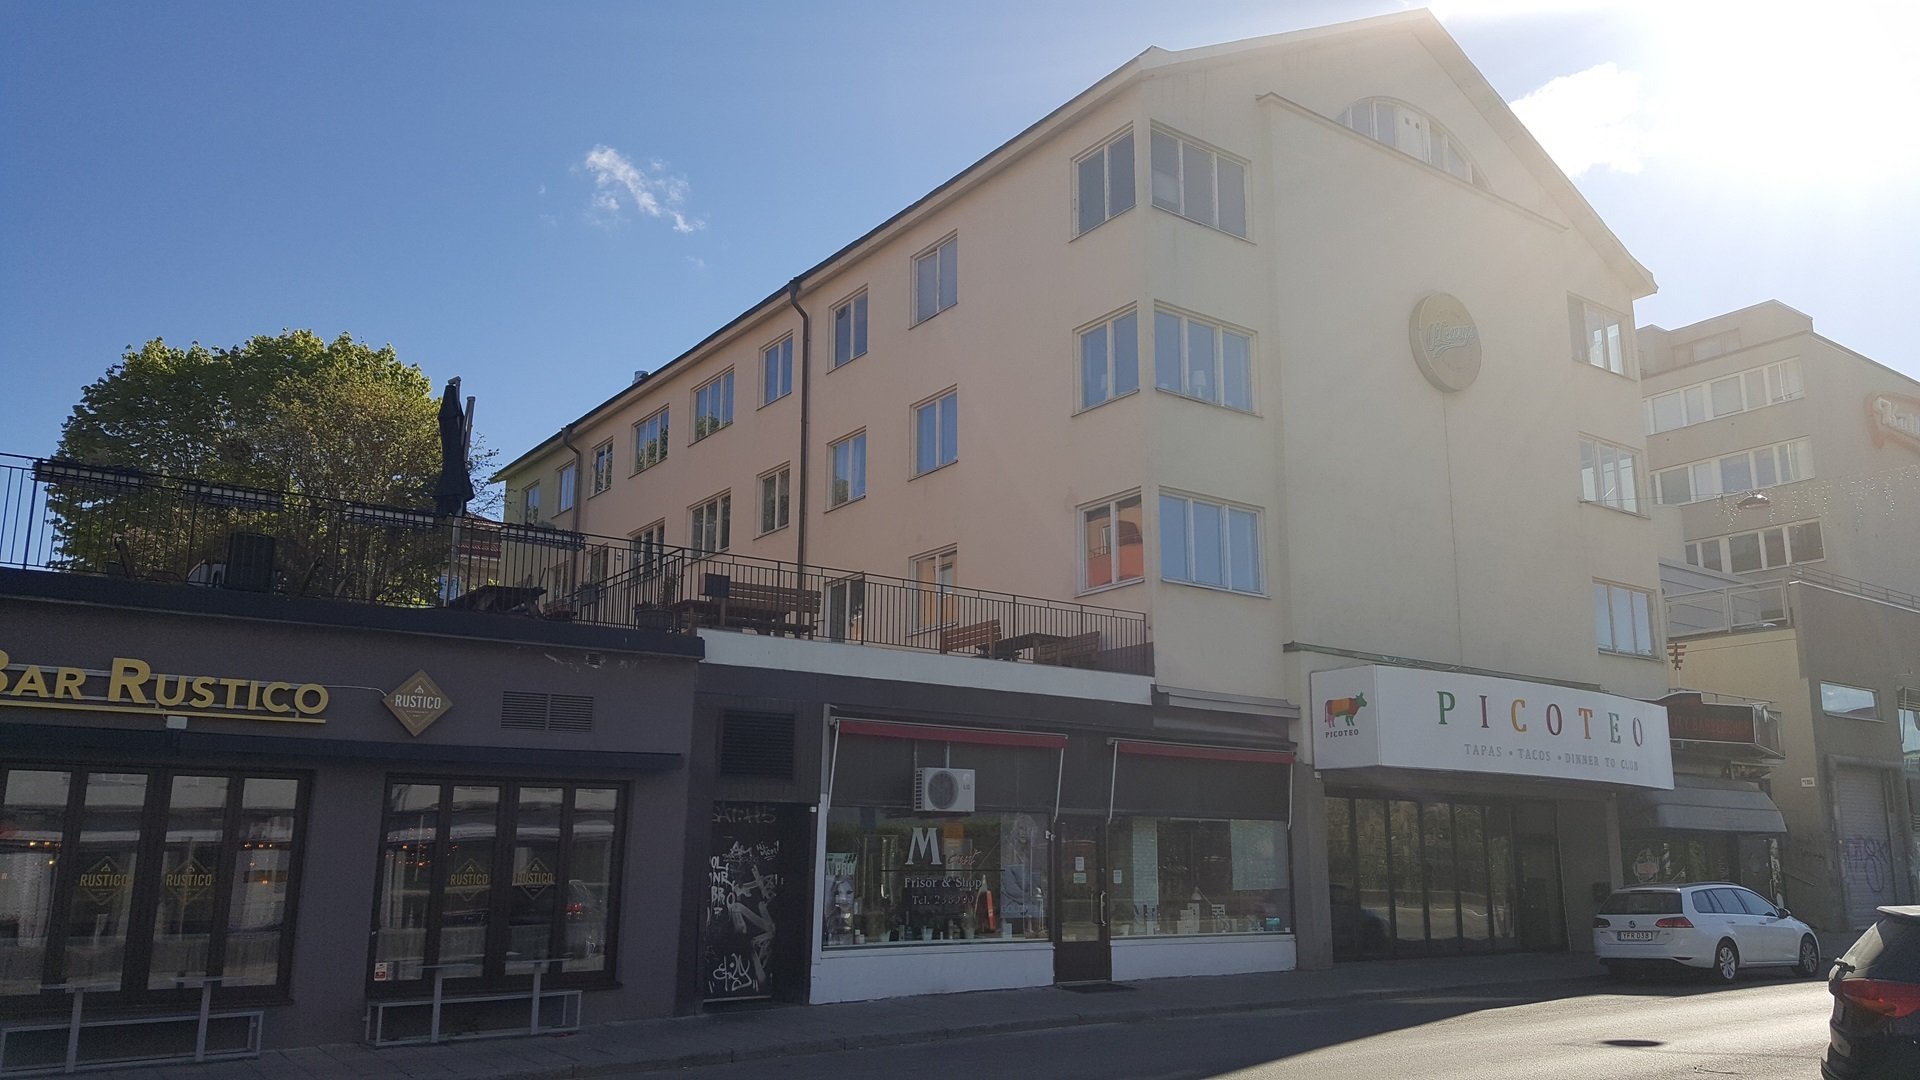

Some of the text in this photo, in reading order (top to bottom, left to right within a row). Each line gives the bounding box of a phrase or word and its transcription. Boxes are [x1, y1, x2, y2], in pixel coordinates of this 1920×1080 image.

[108, 657, 329, 714] RUSTICO
[394, 694, 442, 710] RUSTICO
[1436, 690, 1644, 747] PICOTEO
[1325, 729, 1359, 738] PICOTEO
[1464, 744, 1639, 771] TAPAS TACOS DINNER TO CLUB
[79, 873, 129, 887] RUSTICO
[165, 873, 213, 887] RUSTICO
[449, 873, 489, 885] RUSTICO
[516, 872, 553, 883] RUSTICO
[941, 877, 951, 888] &
[955, 877, 982, 890] Shop
